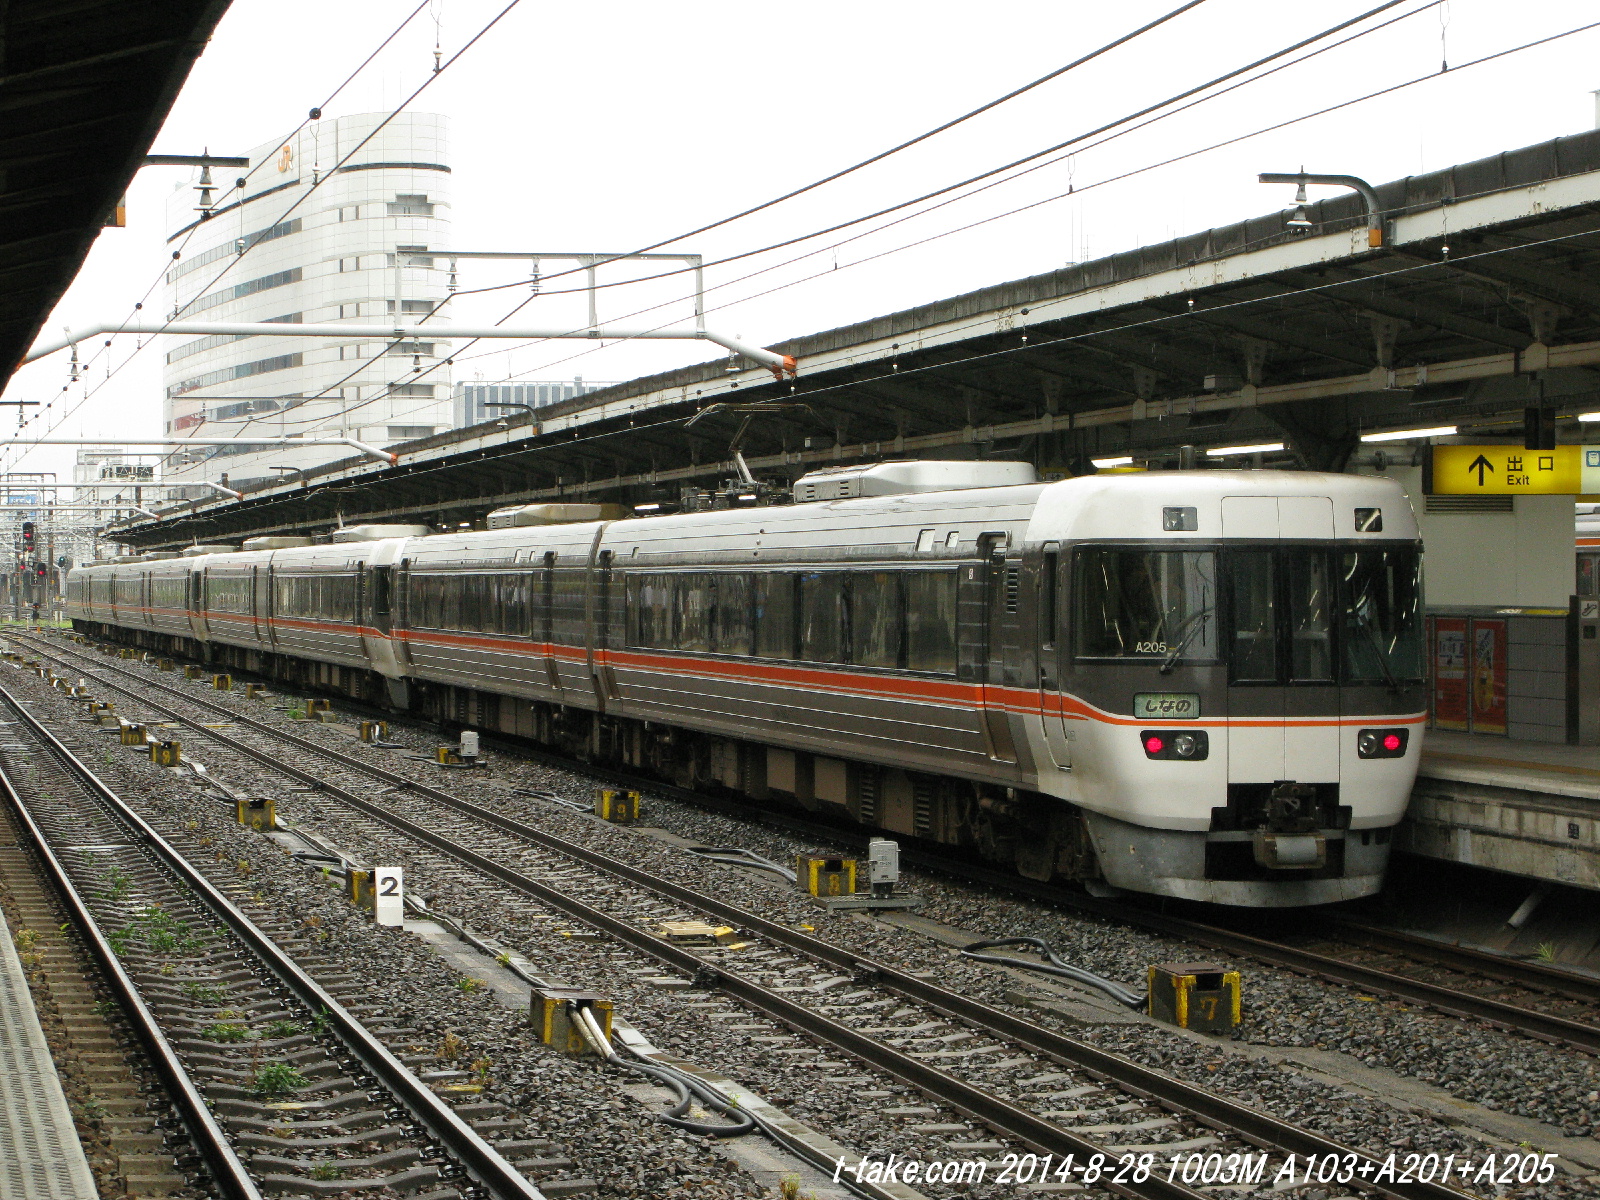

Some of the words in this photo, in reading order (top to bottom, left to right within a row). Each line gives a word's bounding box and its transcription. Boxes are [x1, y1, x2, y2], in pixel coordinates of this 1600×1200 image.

[1507, 455, 1554, 472] 出口
[1507, 474, 1530, 486] Exit
[1135, 641, 1167, 653] A205
[1145, 699, 1192, 713] しなの
[379, 876, 400, 897] 2
[1200, 996, 1219, 1020] 7
